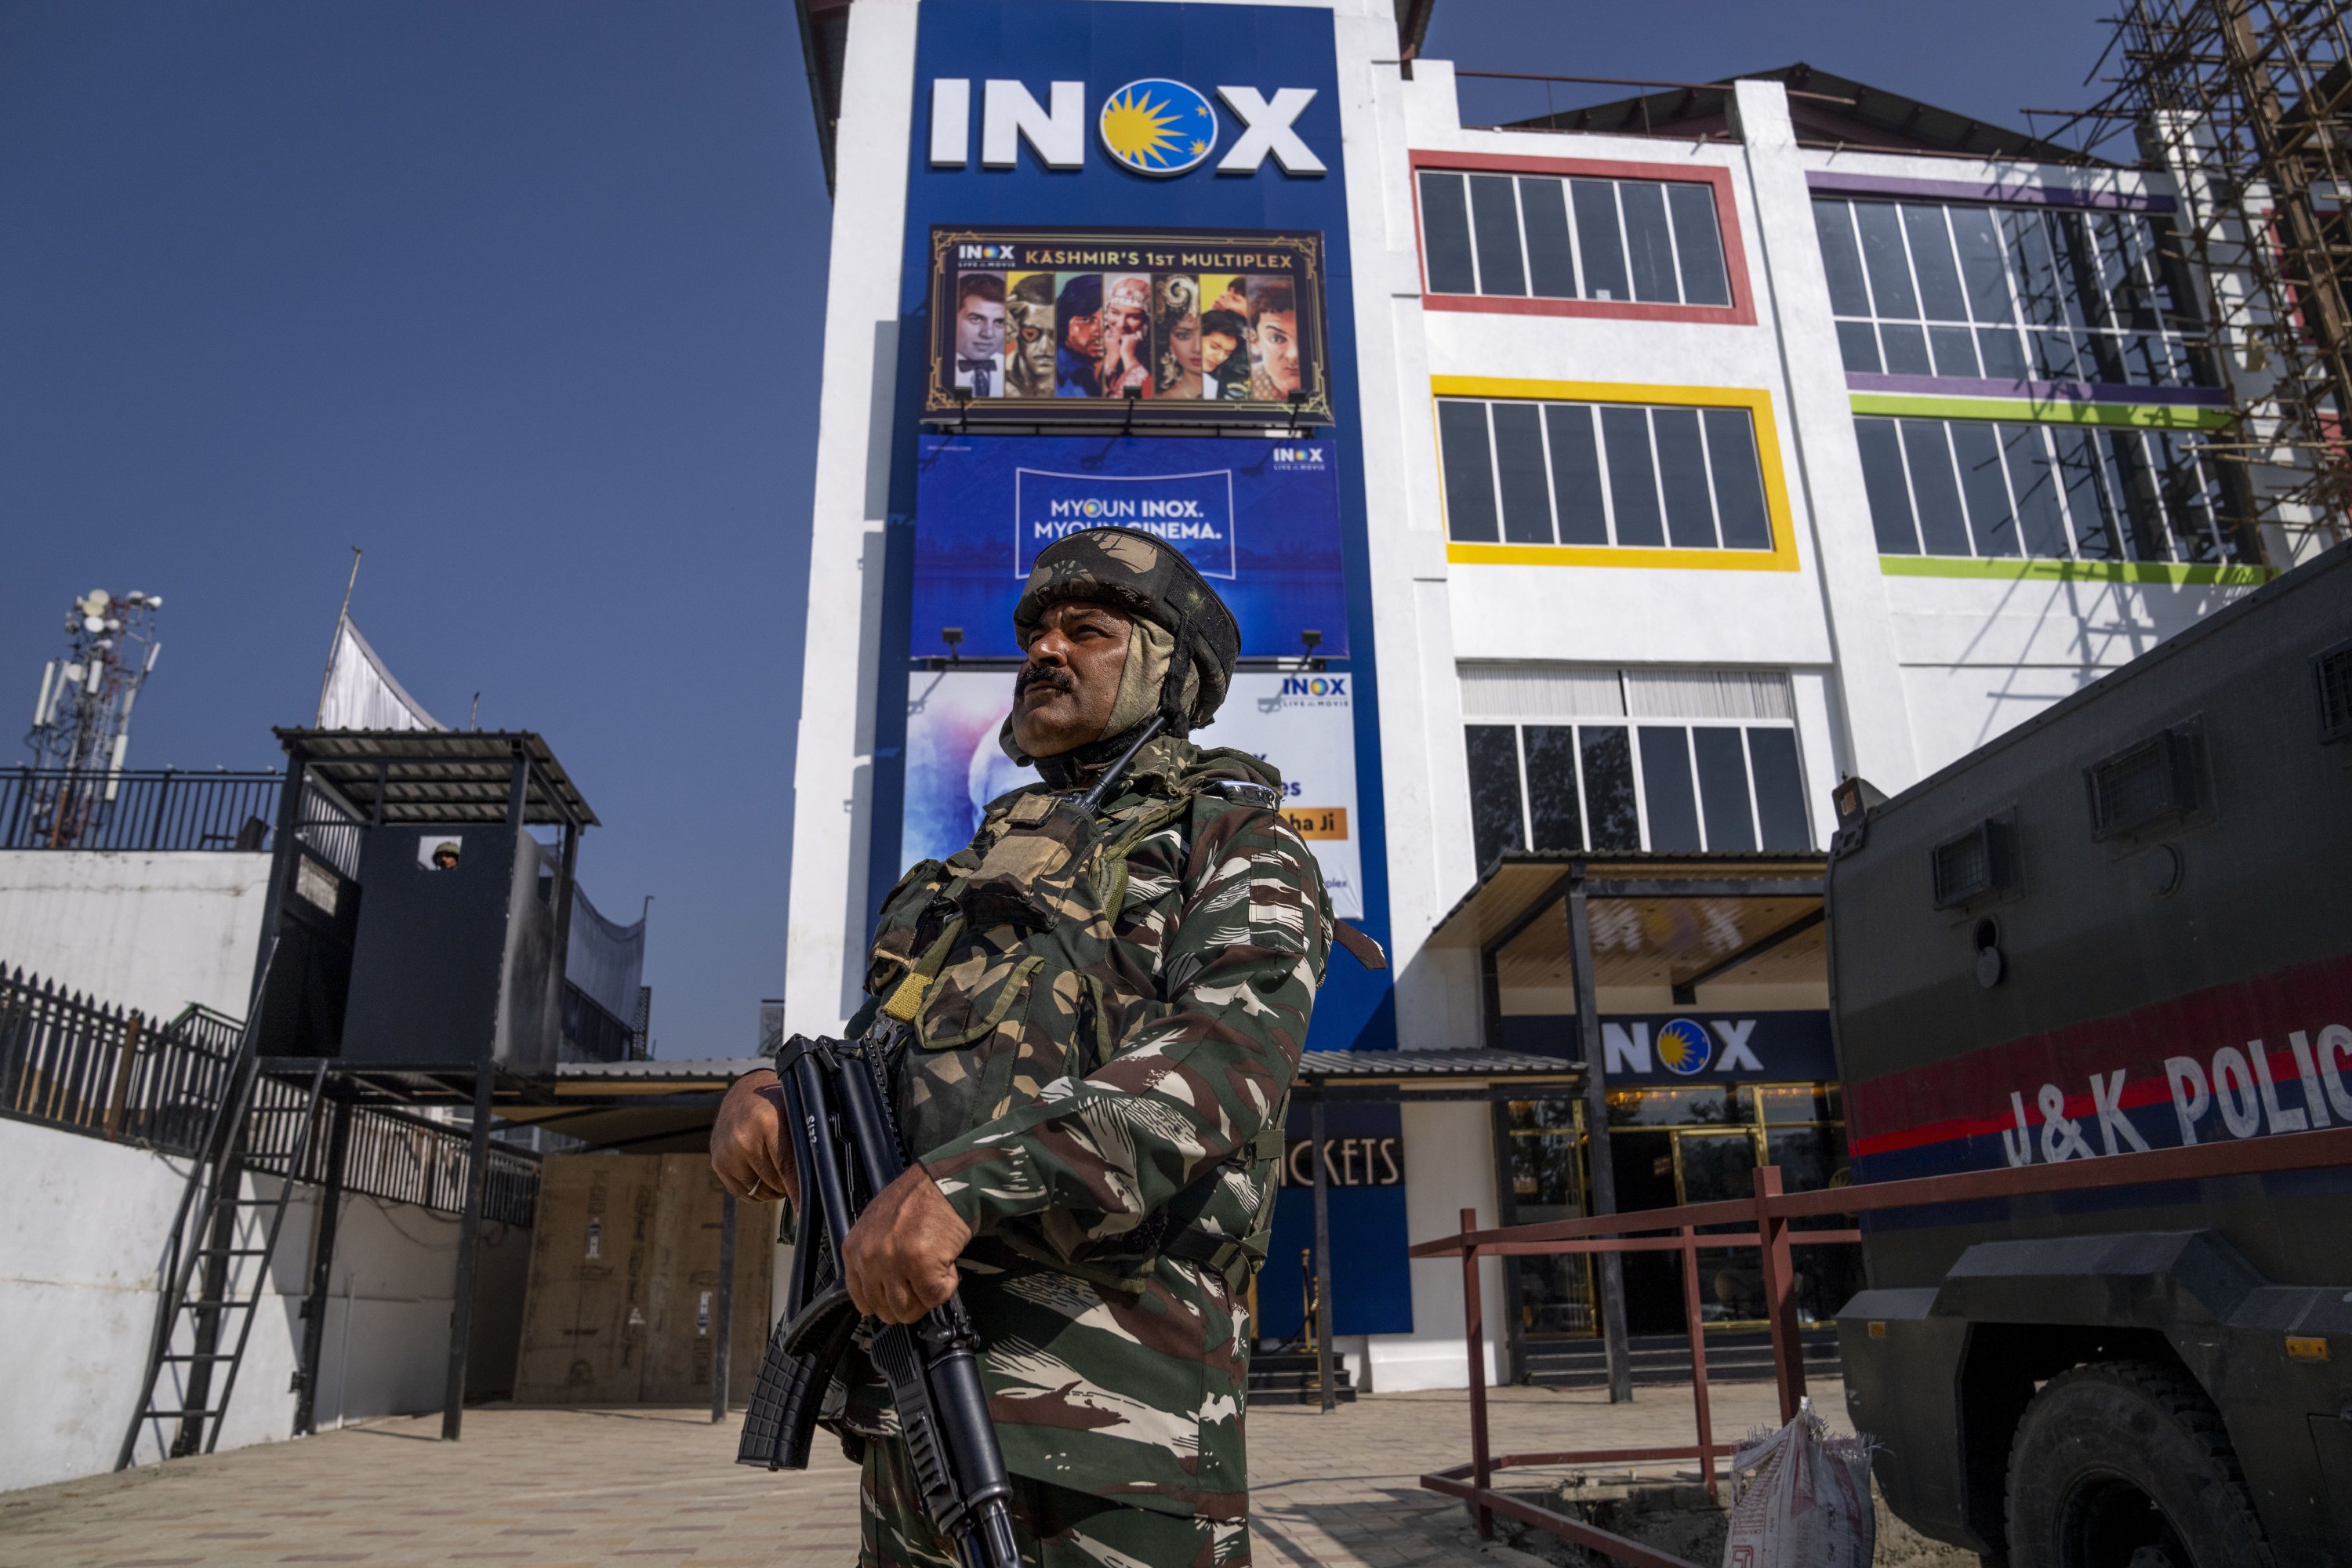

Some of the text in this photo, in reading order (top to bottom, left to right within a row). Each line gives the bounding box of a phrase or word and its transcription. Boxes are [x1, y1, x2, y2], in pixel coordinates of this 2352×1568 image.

[931, 78, 1327, 178] INOX
[959, 245, 1015, 260] INOX
[1025, 249, 1139, 266] KASHMIR'S
[1181, 252, 1293, 268] MULTIPLEX
[1273, 448, 1323, 463] INOX
[1051, 499, 1204, 518] MYOUN INOX.
[1283, 678, 1346, 696] INOX
[1320, 813, 1335, 831] Ji
[1602, 1018, 1764, 1076] NOX
[2164, 1024, 2352, 1146] POLIC
[1279, 1138, 1399, 1186] ICKETS
